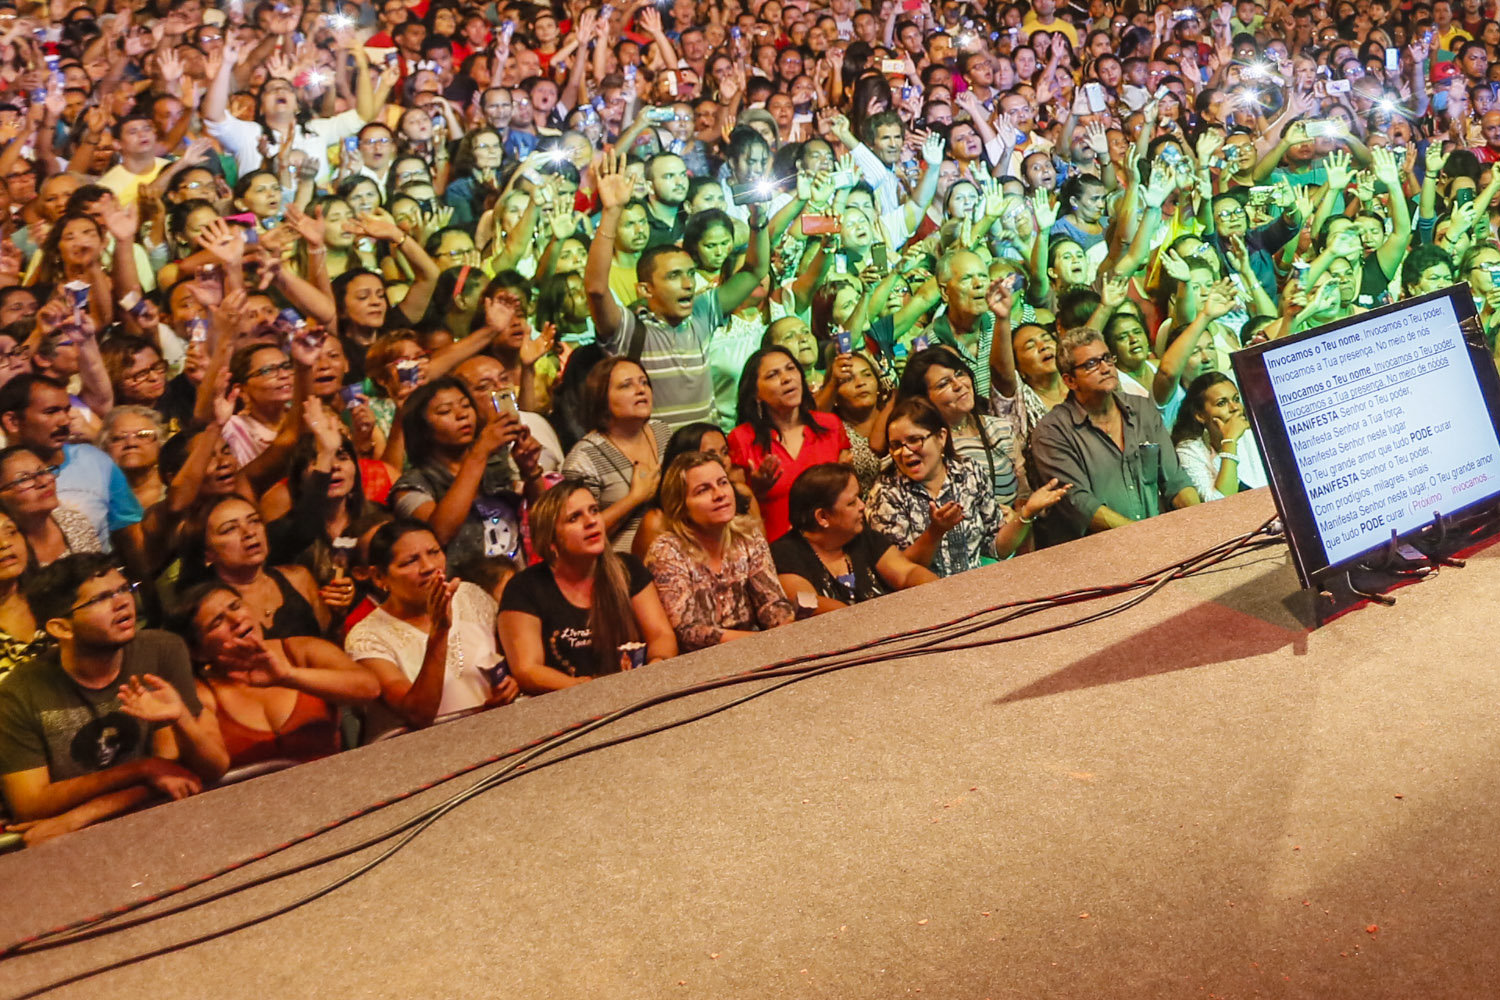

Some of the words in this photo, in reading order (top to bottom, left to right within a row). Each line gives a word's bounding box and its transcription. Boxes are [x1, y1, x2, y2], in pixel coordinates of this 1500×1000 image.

[1266, 348, 1314, 369] Invocamos
[1320, 341, 1337, 351] Teu
[1362, 320, 1402, 338] Invocamos
[1406, 313, 1423, 324] Teu
[1271, 365, 1315, 385] Invocamos
[1321, 357, 1338, 368] Tua
[1374, 340, 1388, 351] No
[1386, 335, 1406, 347] meio
[1405, 331, 1416, 341] de
[1415, 326, 1430, 338] nós
[1277, 382, 1325, 404] Invocamos
[1331, 375, 1348, 385] Teu
[1373, 352, 1414, 373] Invocamos
[1417, 346, 1434, 358] Teu
[1282, 399, 1327, 420] Invocamos
[1331, 391, 1350, 402] Tua
[1385, 374, 1399, 386] No
[1397, 368, 1418, 381] meio
[1416, 363, 1428, 375] de
[1288, 411, 1339, 436] MANIFESTA
[1338, 402, 1366, 418] Senhor
[1372, 394, 1389, 405] Teu
[1292, 432, 1332, 452] Manifesta
[1331, 421, 1360, 438] Senhor
[1366, 413, 1383, 424] Tua
[1297, 447, 1338, 468] Manifesta
[1337, 436, 1365, 454] Senhor
[1365, 428, 1388, 442] neste
[1386, 421, 1406, 435] lugar
[1311, 468, 1329, 480] Teu
[1328, 457, 1356, 477] grande
[1356, 449, 1377, 464] amor
[1377, 444, 1393, 457] que
[1391, 436, 1410, 450] tudo
[1409, 426, 1433, 443] PODE
[1432, 420, 1451, 434] curar
[1308, 473, 1359, 500] MANIFESTA
[1358, 463, 1387, 480] Senhor
[1392, 455, 1409, 466] Teu
[1313, 502, 1335, 516] Com
[1406, 463, 1429, 479] sinais
[1318, 511, 1358, 533] Manifesta
[1357, 498, 1386, 516] Senhor
[1386, 490, 1408, 505] neste
[1435, 472, 1451, 483] Teu
[1450, 461, 1476, 480] grande
[1475, 454, 1493, 468] amor
[1324, 536, 1341, 550] que
[1340, 527, 1360, 542] tudo
[1359, 515, 1385, 534] PODE
[1385, 508, 1405, 523] curar
